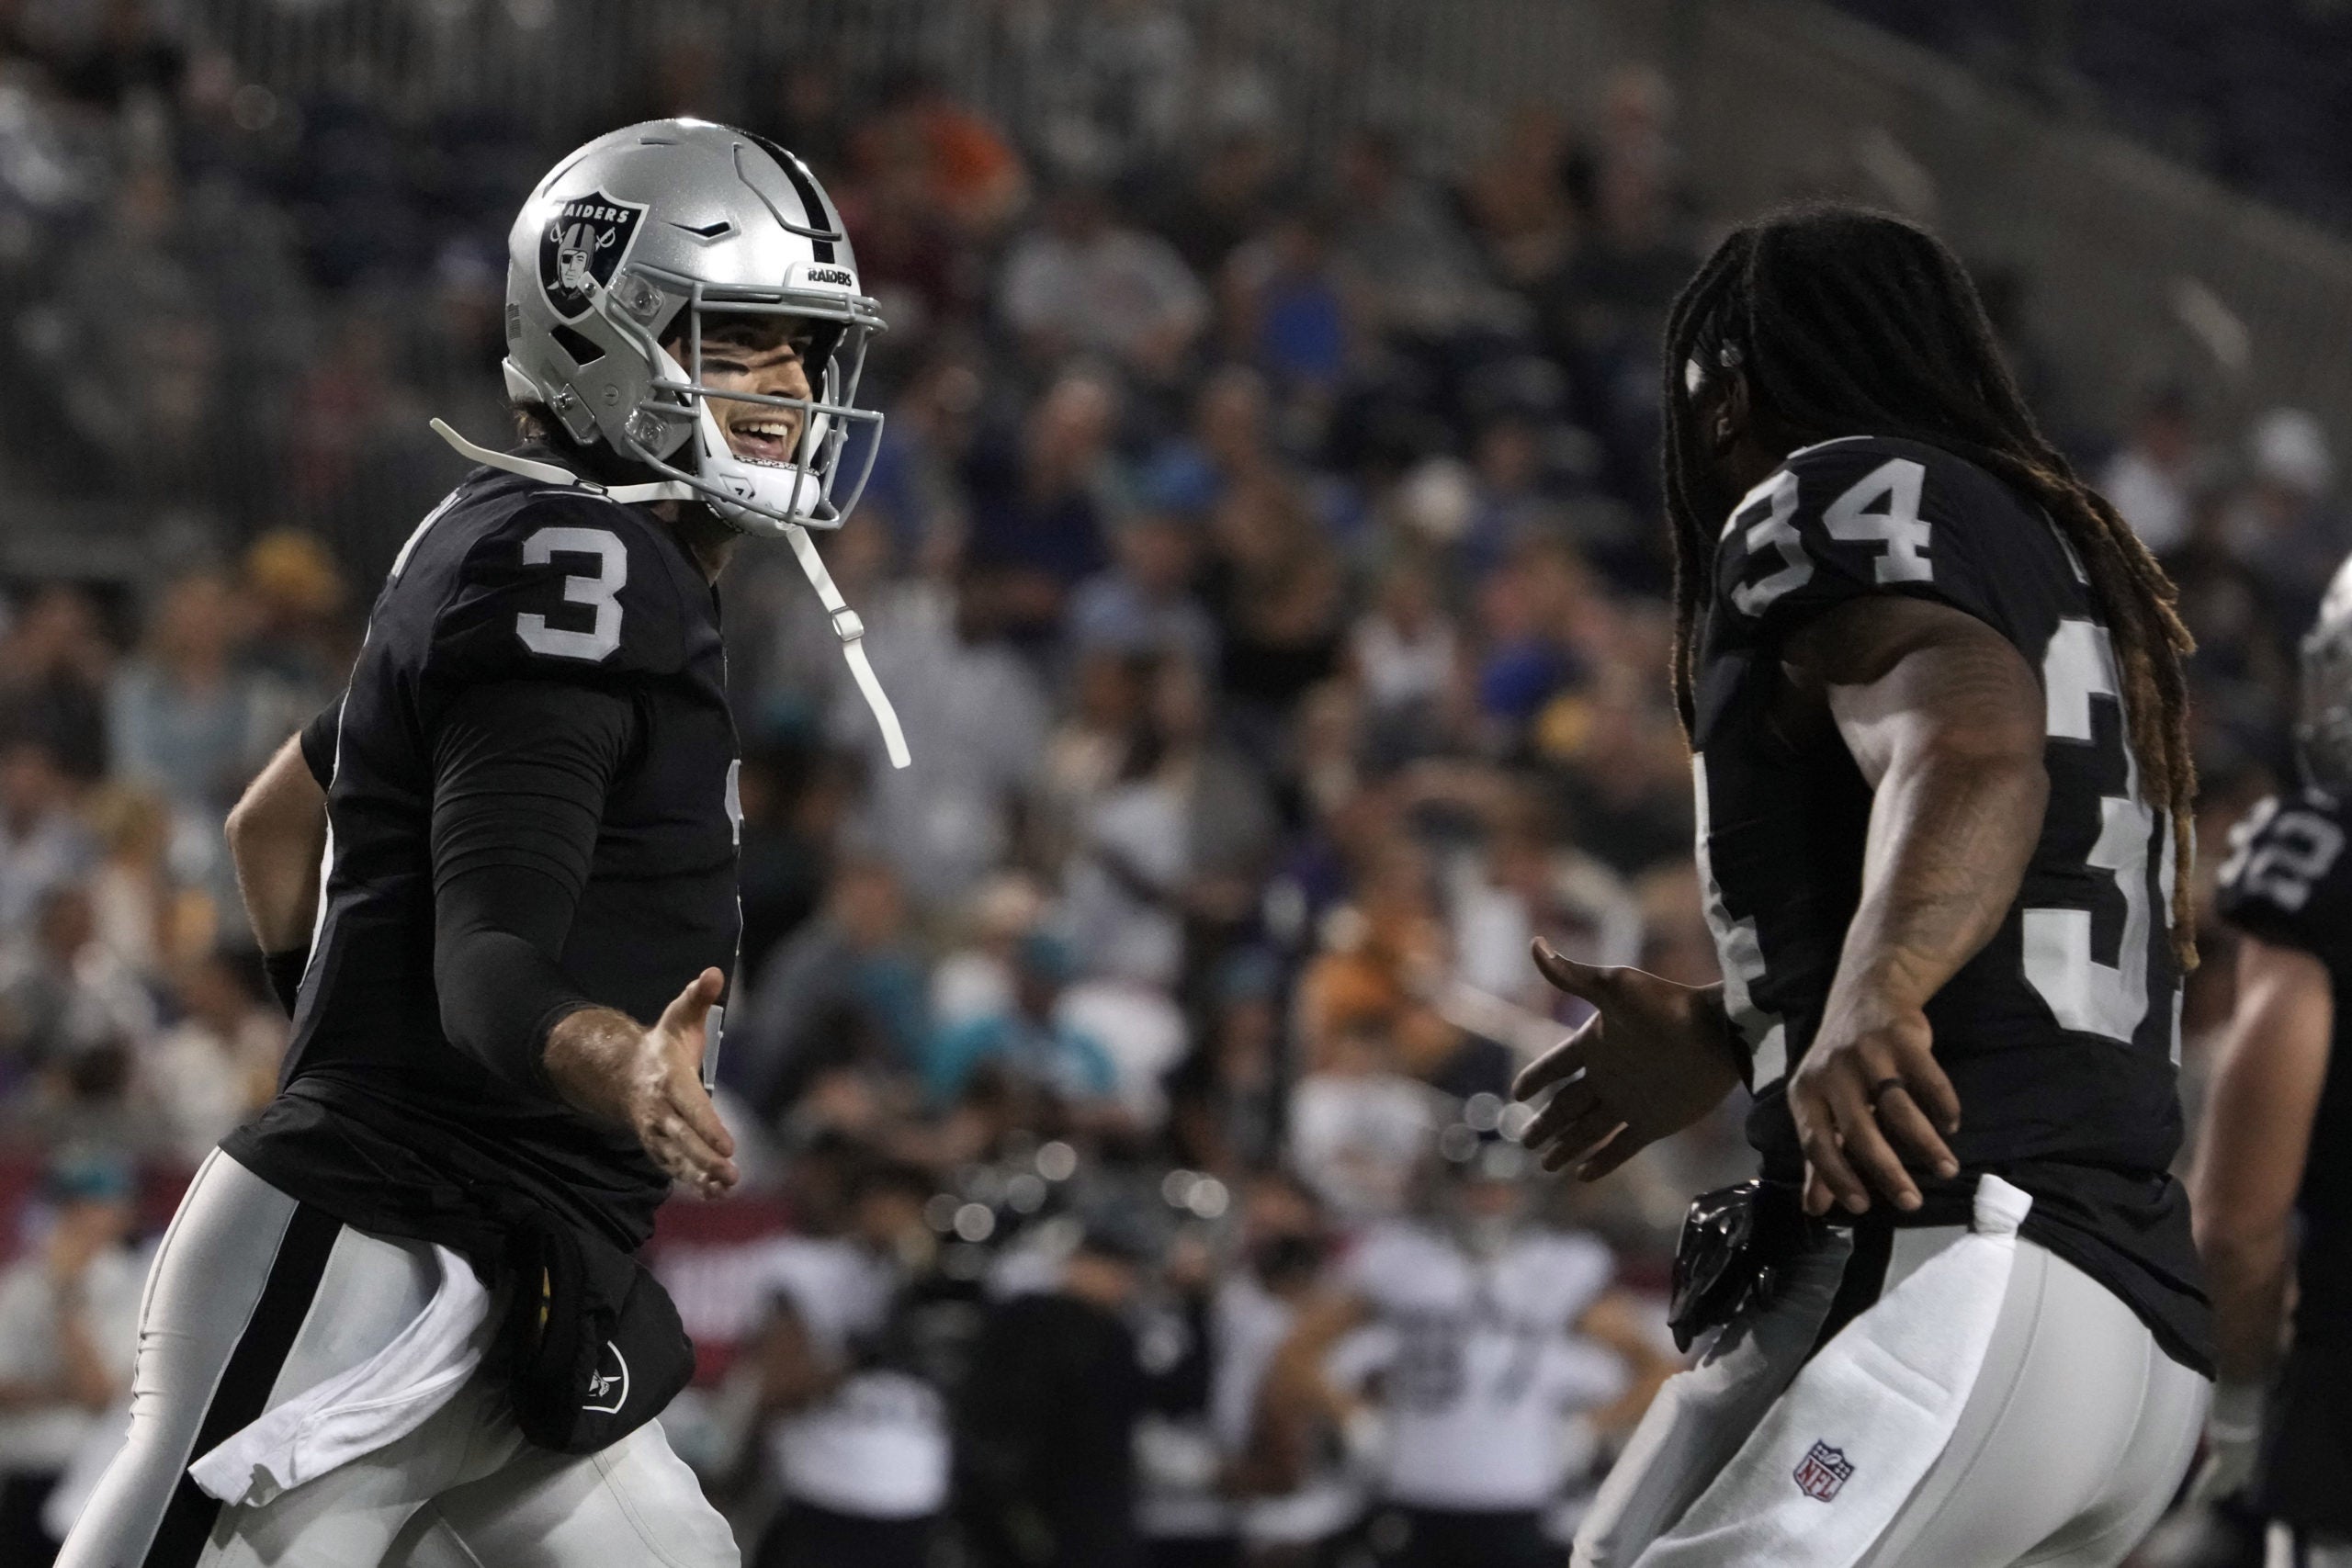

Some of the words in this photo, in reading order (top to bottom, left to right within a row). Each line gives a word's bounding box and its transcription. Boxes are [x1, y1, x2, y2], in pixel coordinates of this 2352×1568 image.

[562, 203, 630, 223] AIDERS
[808, 267, 852, 288] RAIDERS
[1719, 457, 1934, 618] 34
[515, 526, 628, 662] 3
[2021, 617, 2196, 1066] 3
[1797, 1457, 1836, 1499] NFL
